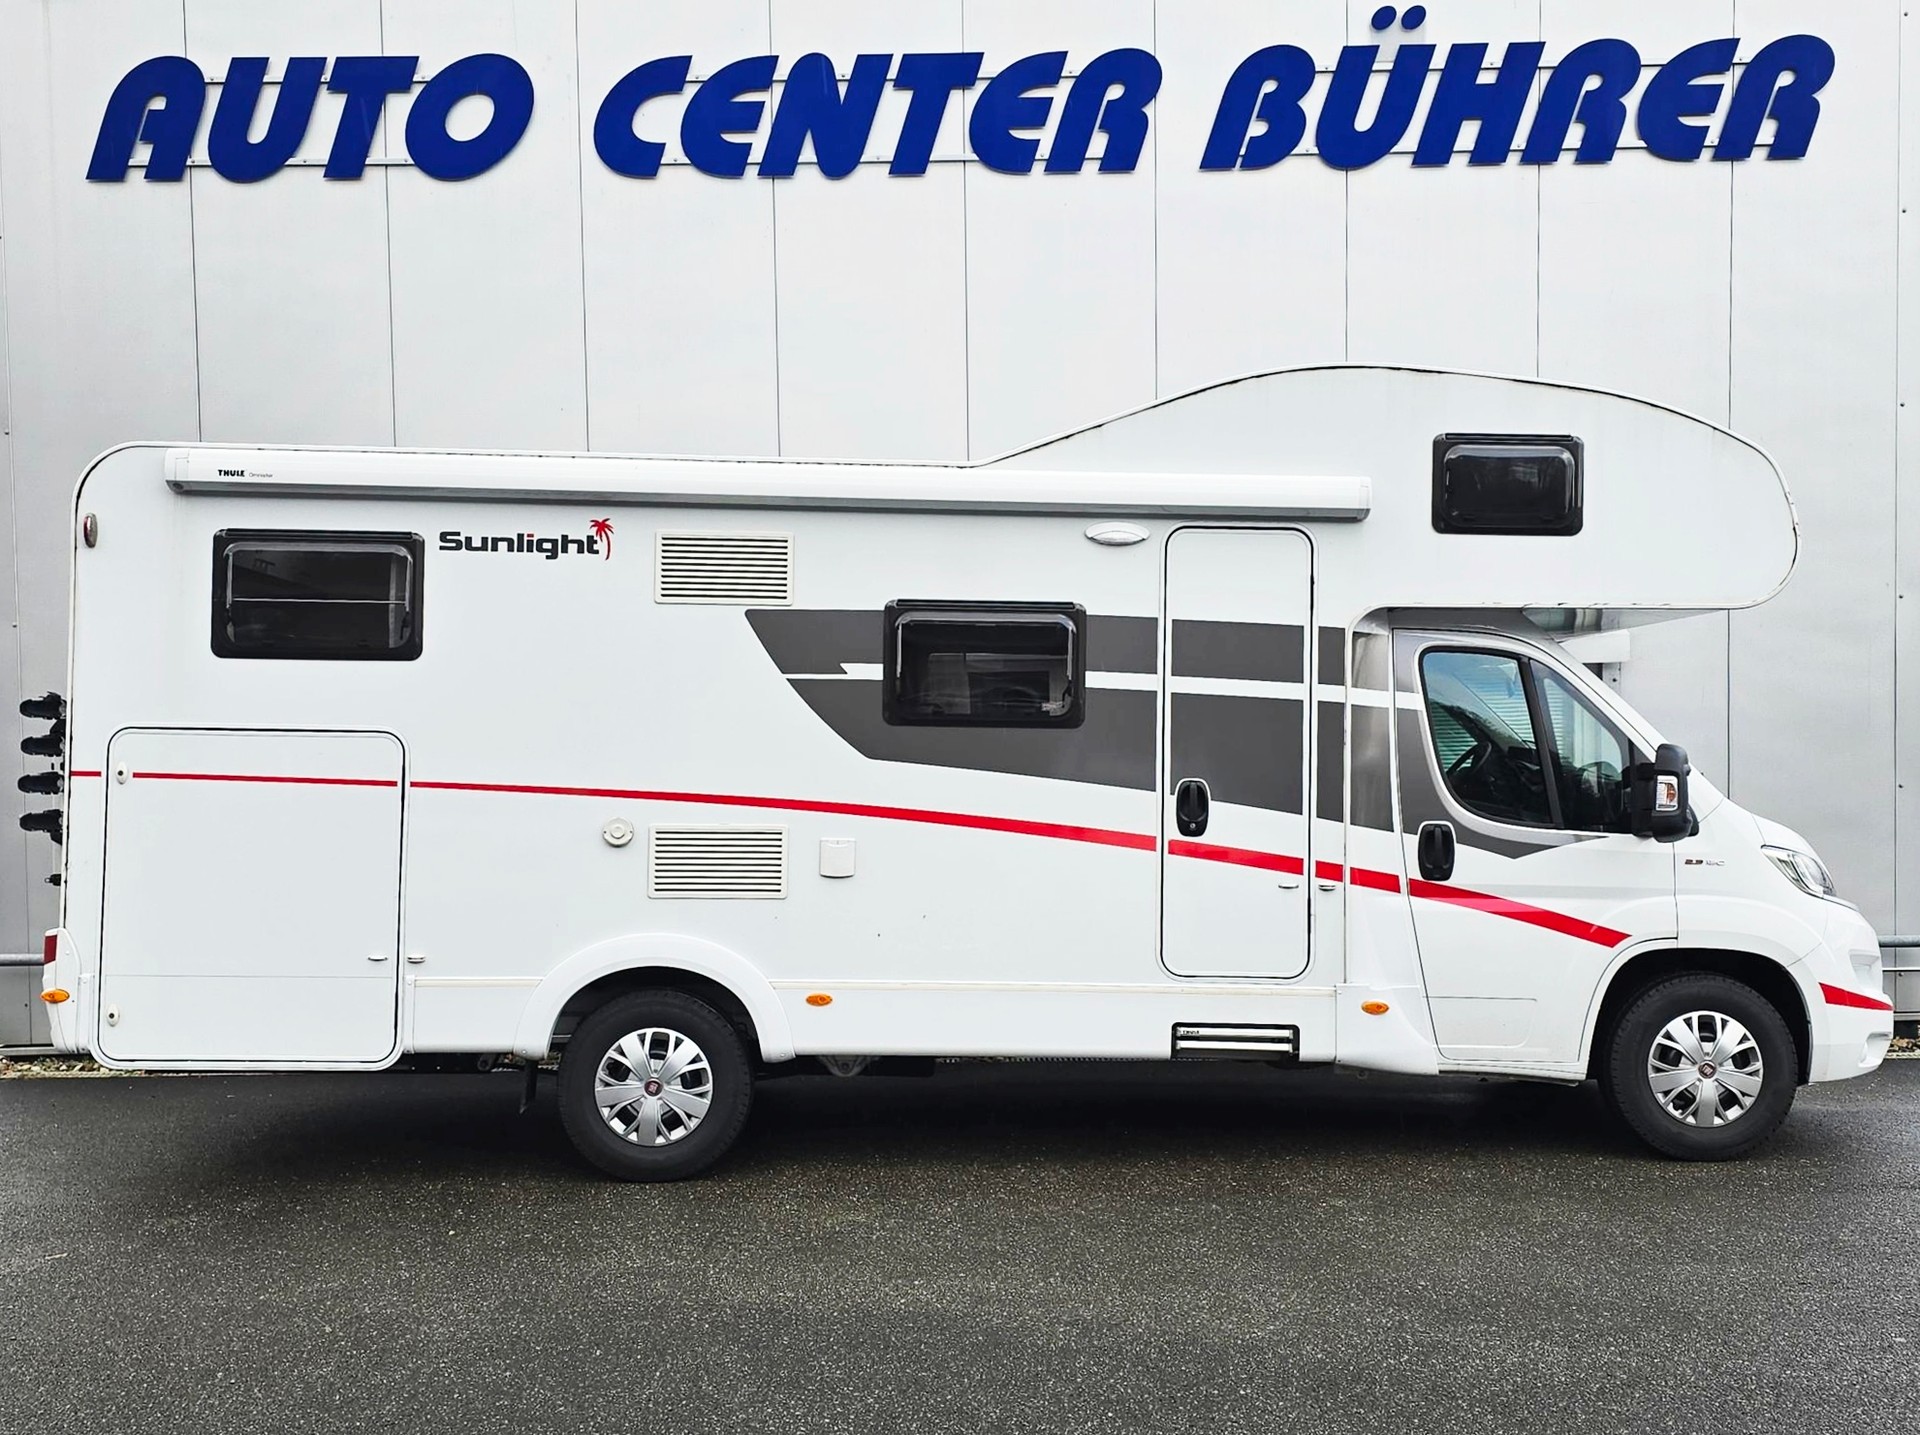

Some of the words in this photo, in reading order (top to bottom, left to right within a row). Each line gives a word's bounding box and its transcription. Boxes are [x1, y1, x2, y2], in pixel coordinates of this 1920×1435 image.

[86, 53, 535, 183] AUTO
[593, 48, 1163, 179] CENTER
[1200, 5, 1836, 171] BÜHRER
[217, 469, 246, 478] THULE
[438, 530, 600, 560] Sunlight
